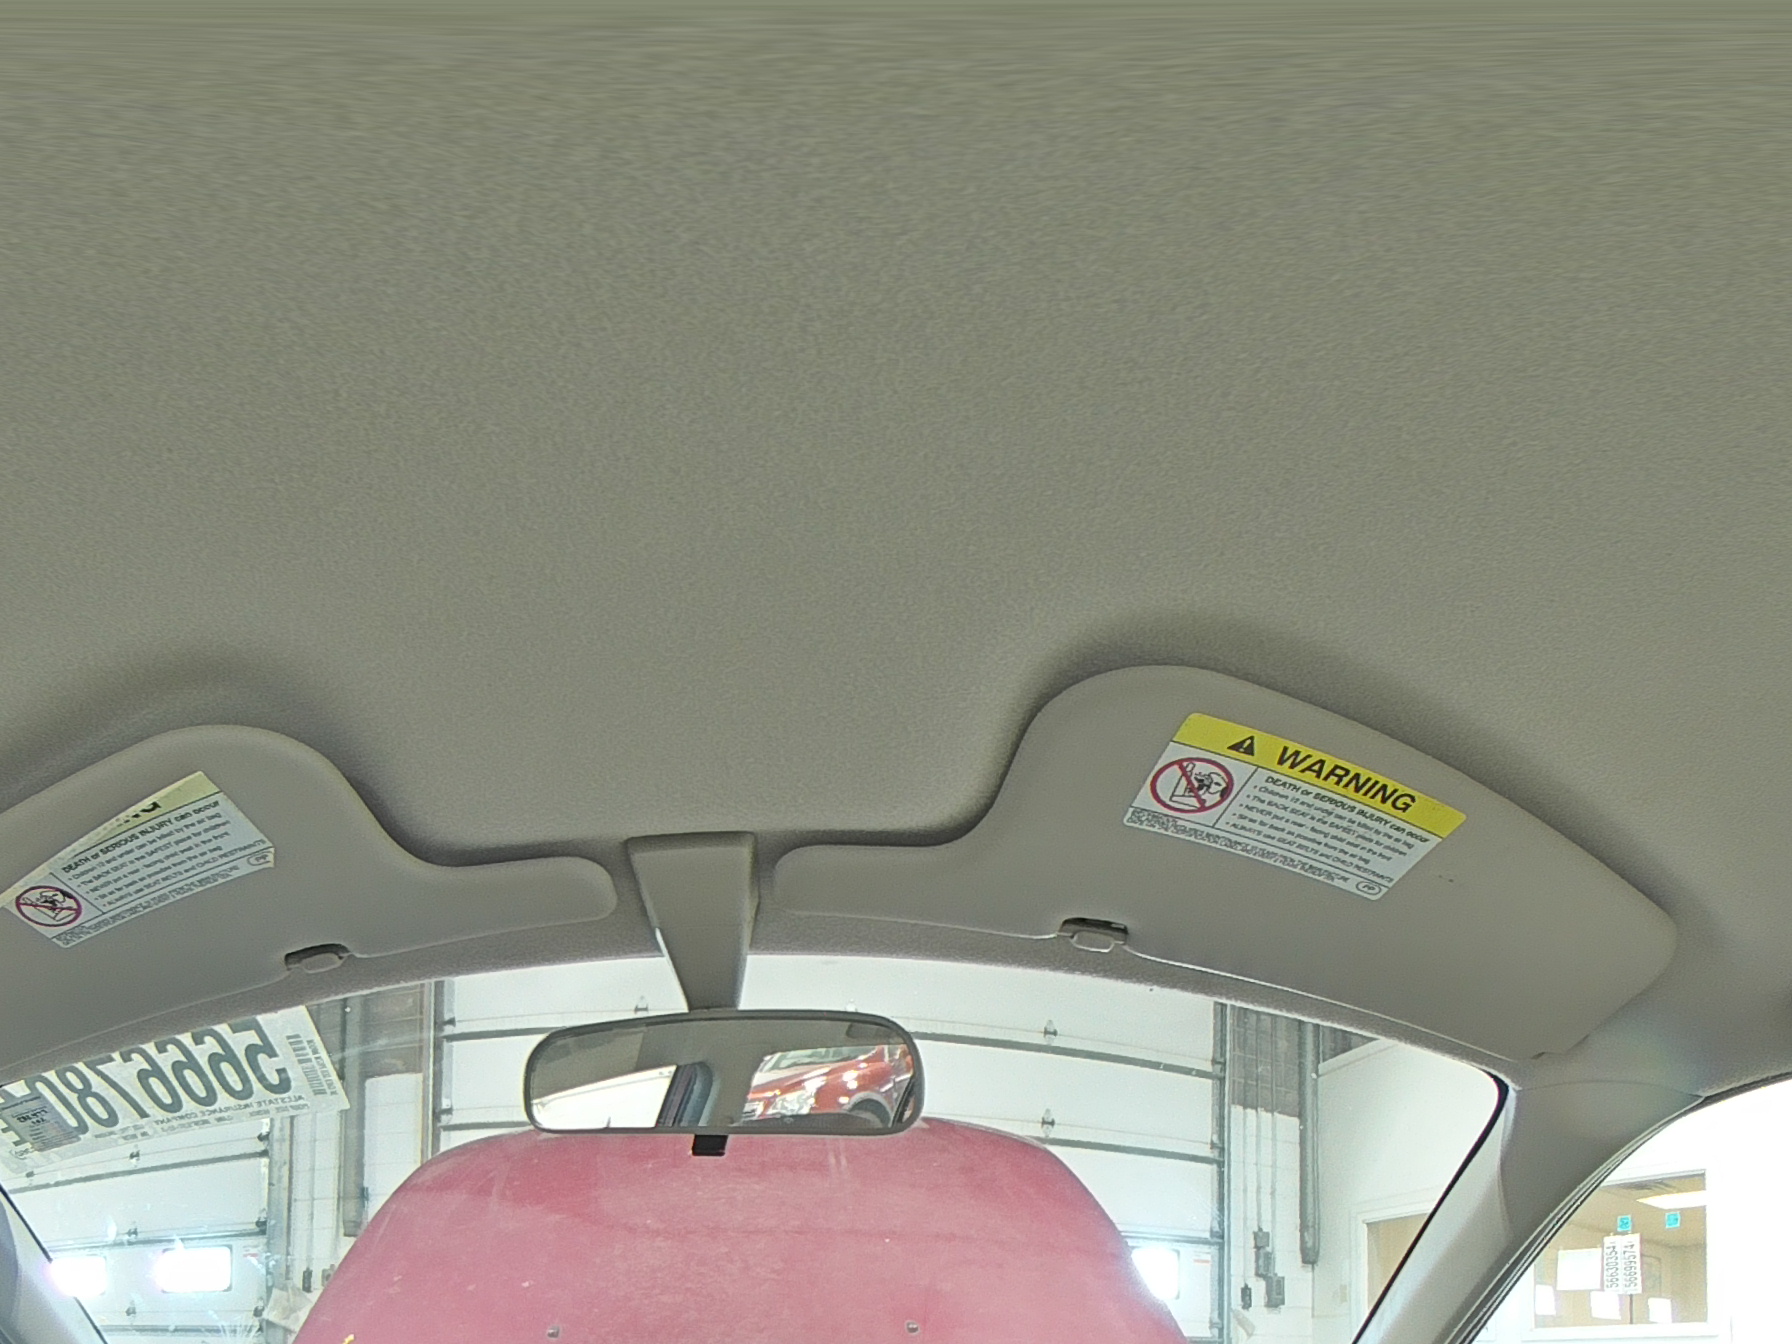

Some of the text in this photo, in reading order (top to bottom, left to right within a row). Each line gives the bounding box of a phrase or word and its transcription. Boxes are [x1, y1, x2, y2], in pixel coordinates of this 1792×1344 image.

[1265, 776, 1300, 792] DEATH
[1277, 746, 1418, 814] WARNING
[62, 857, 91, 872] DEATH
[100, 834, 140, 854] SERIOUS
[139, 819, 173, 836] INJURY
